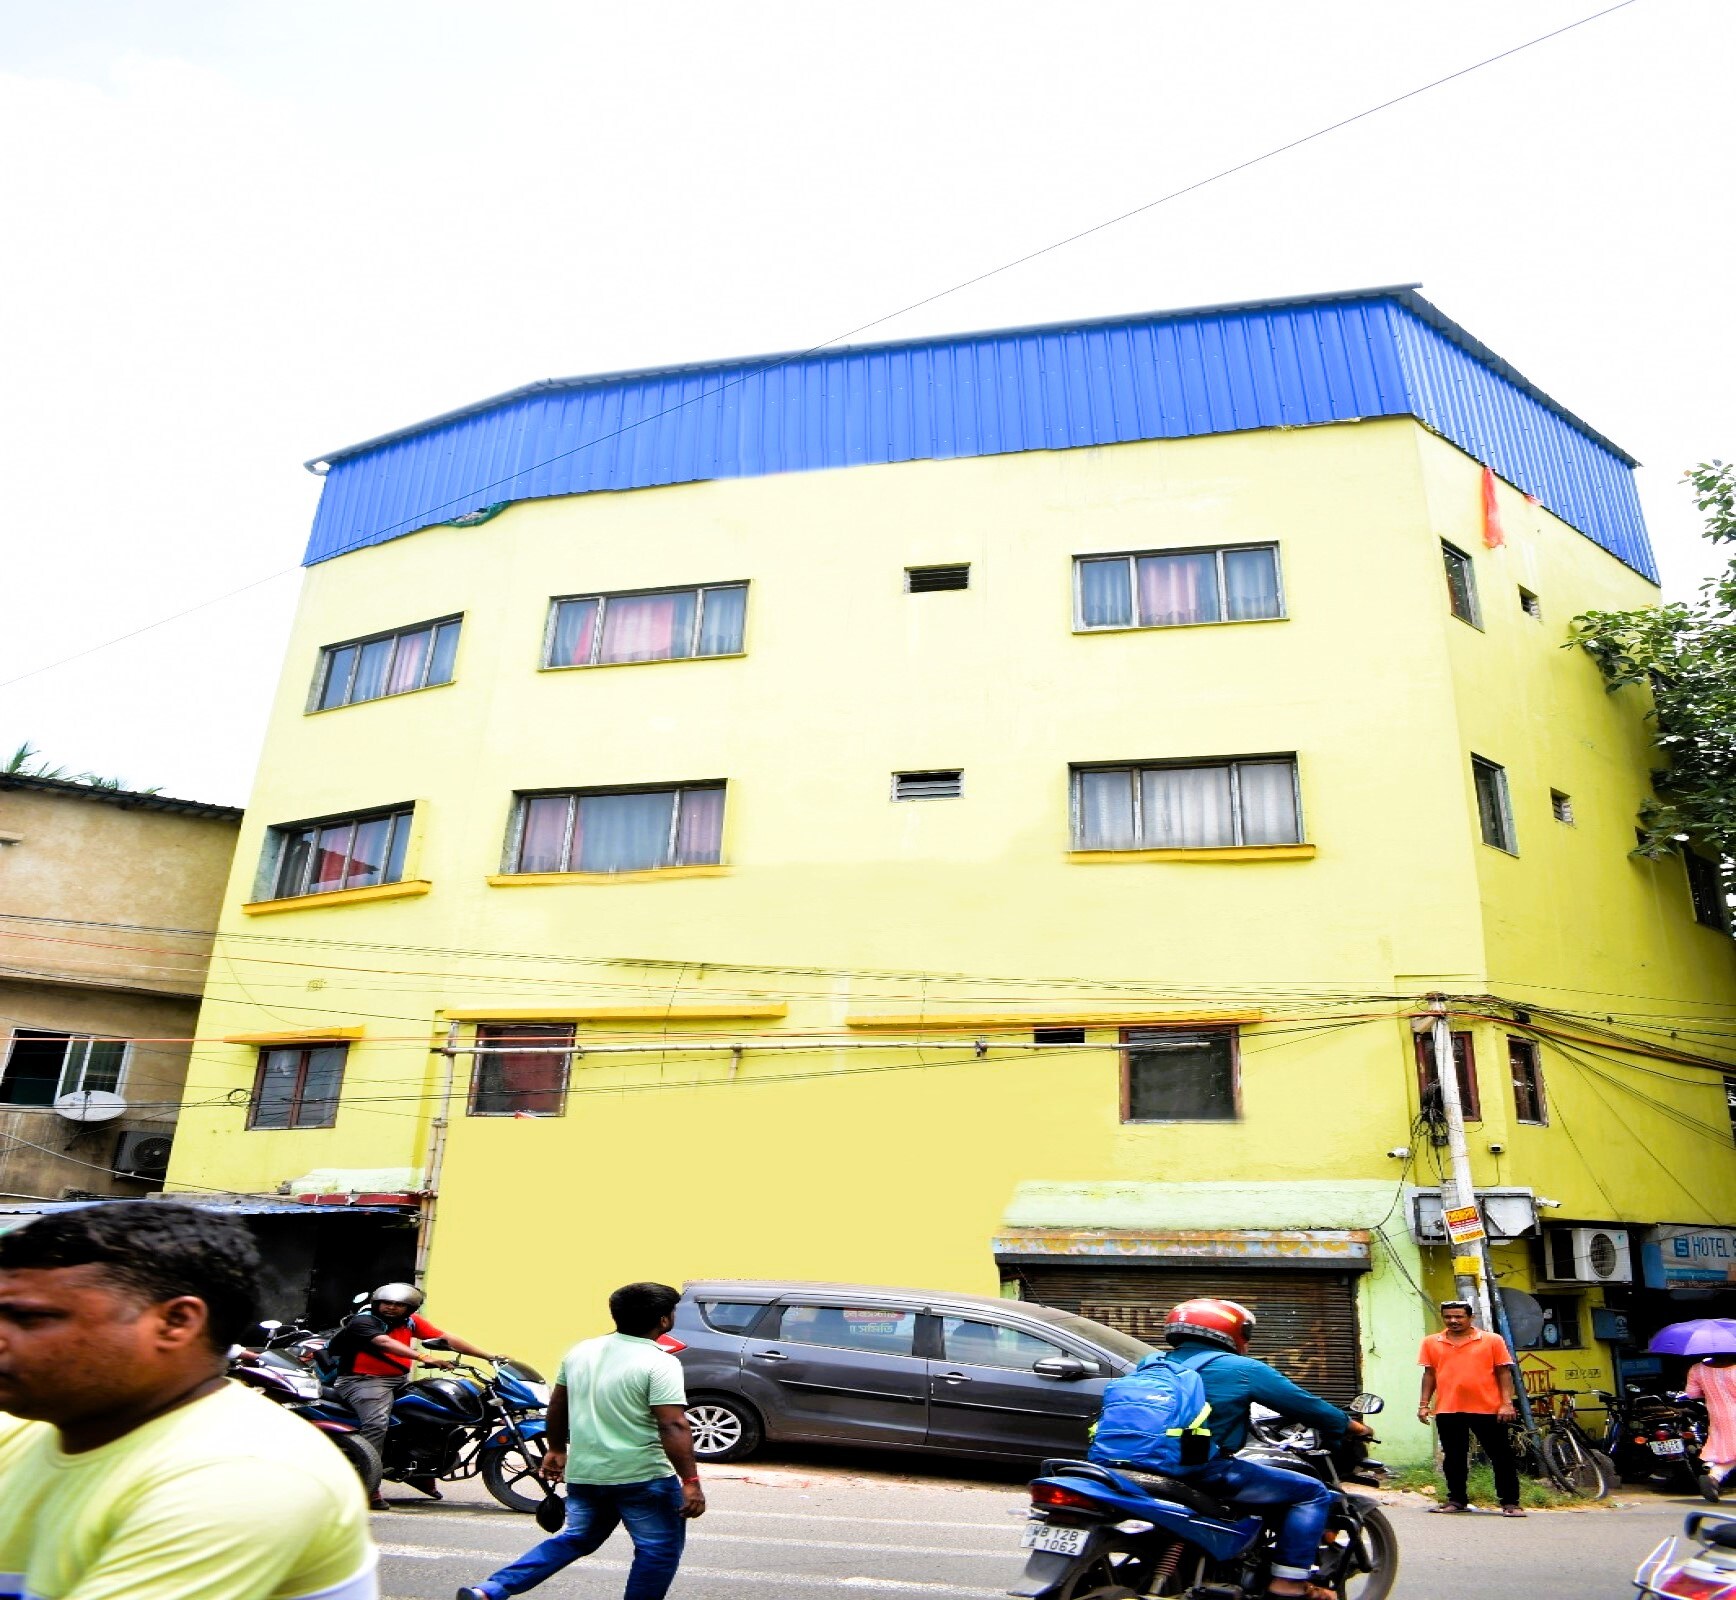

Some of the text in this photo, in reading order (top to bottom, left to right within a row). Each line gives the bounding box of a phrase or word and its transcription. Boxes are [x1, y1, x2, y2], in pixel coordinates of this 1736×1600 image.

[1691, 1236, 1730, 1257] HOTEL
[1521, 1370, 1554, 1394] OTEL
[1033, 1525, 1079, 1541] WB 12B
[1028, 1537, 1078, 1553] A 1062
